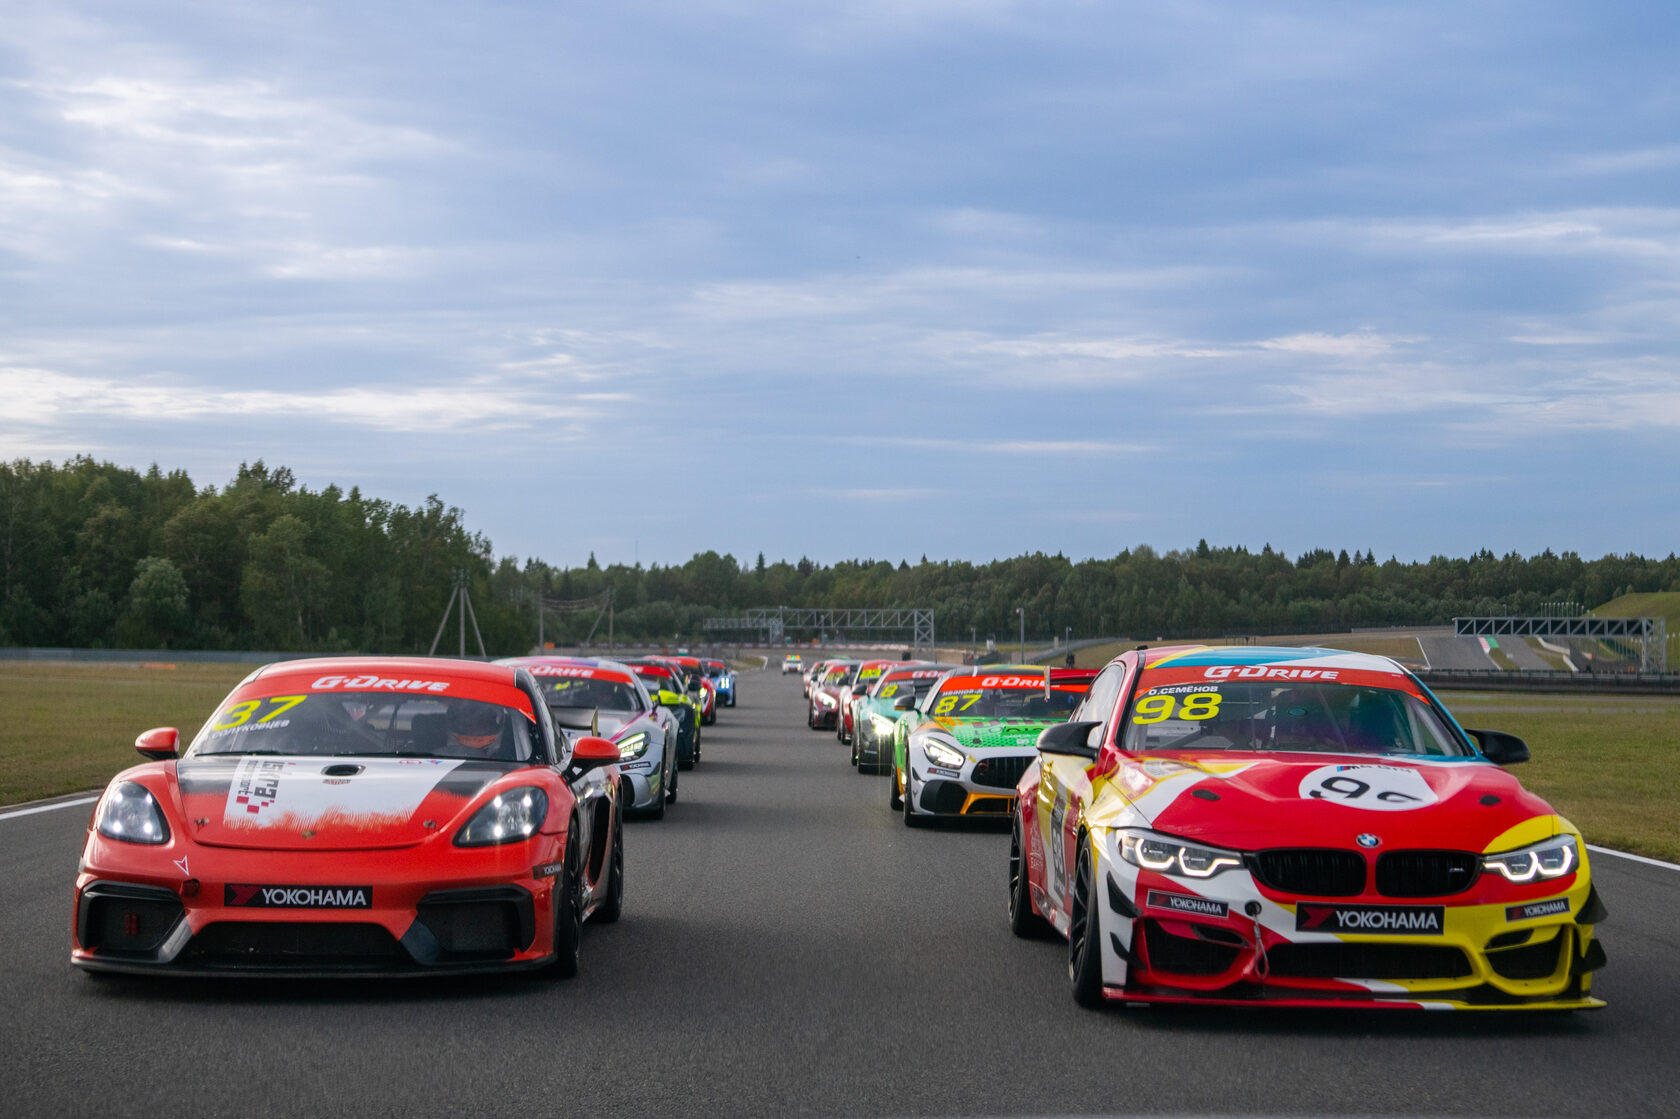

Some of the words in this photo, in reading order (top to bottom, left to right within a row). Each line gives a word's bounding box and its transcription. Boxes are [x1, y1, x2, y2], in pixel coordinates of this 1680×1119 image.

[881, 684, 898, 697] 8
[212, 695, 307, 731] 37
[935, 694, 982, 714] 87
[1132, 692, 1223, 725] 98
[262, 888, 367, 906] YOKOHAMA
[1170, 896, 1222, 915] YOKOHAMA
[1524, 902, 1566, 917] YOKOHAMA
[1336, 911, 1439, 930] YOKOHAMA
